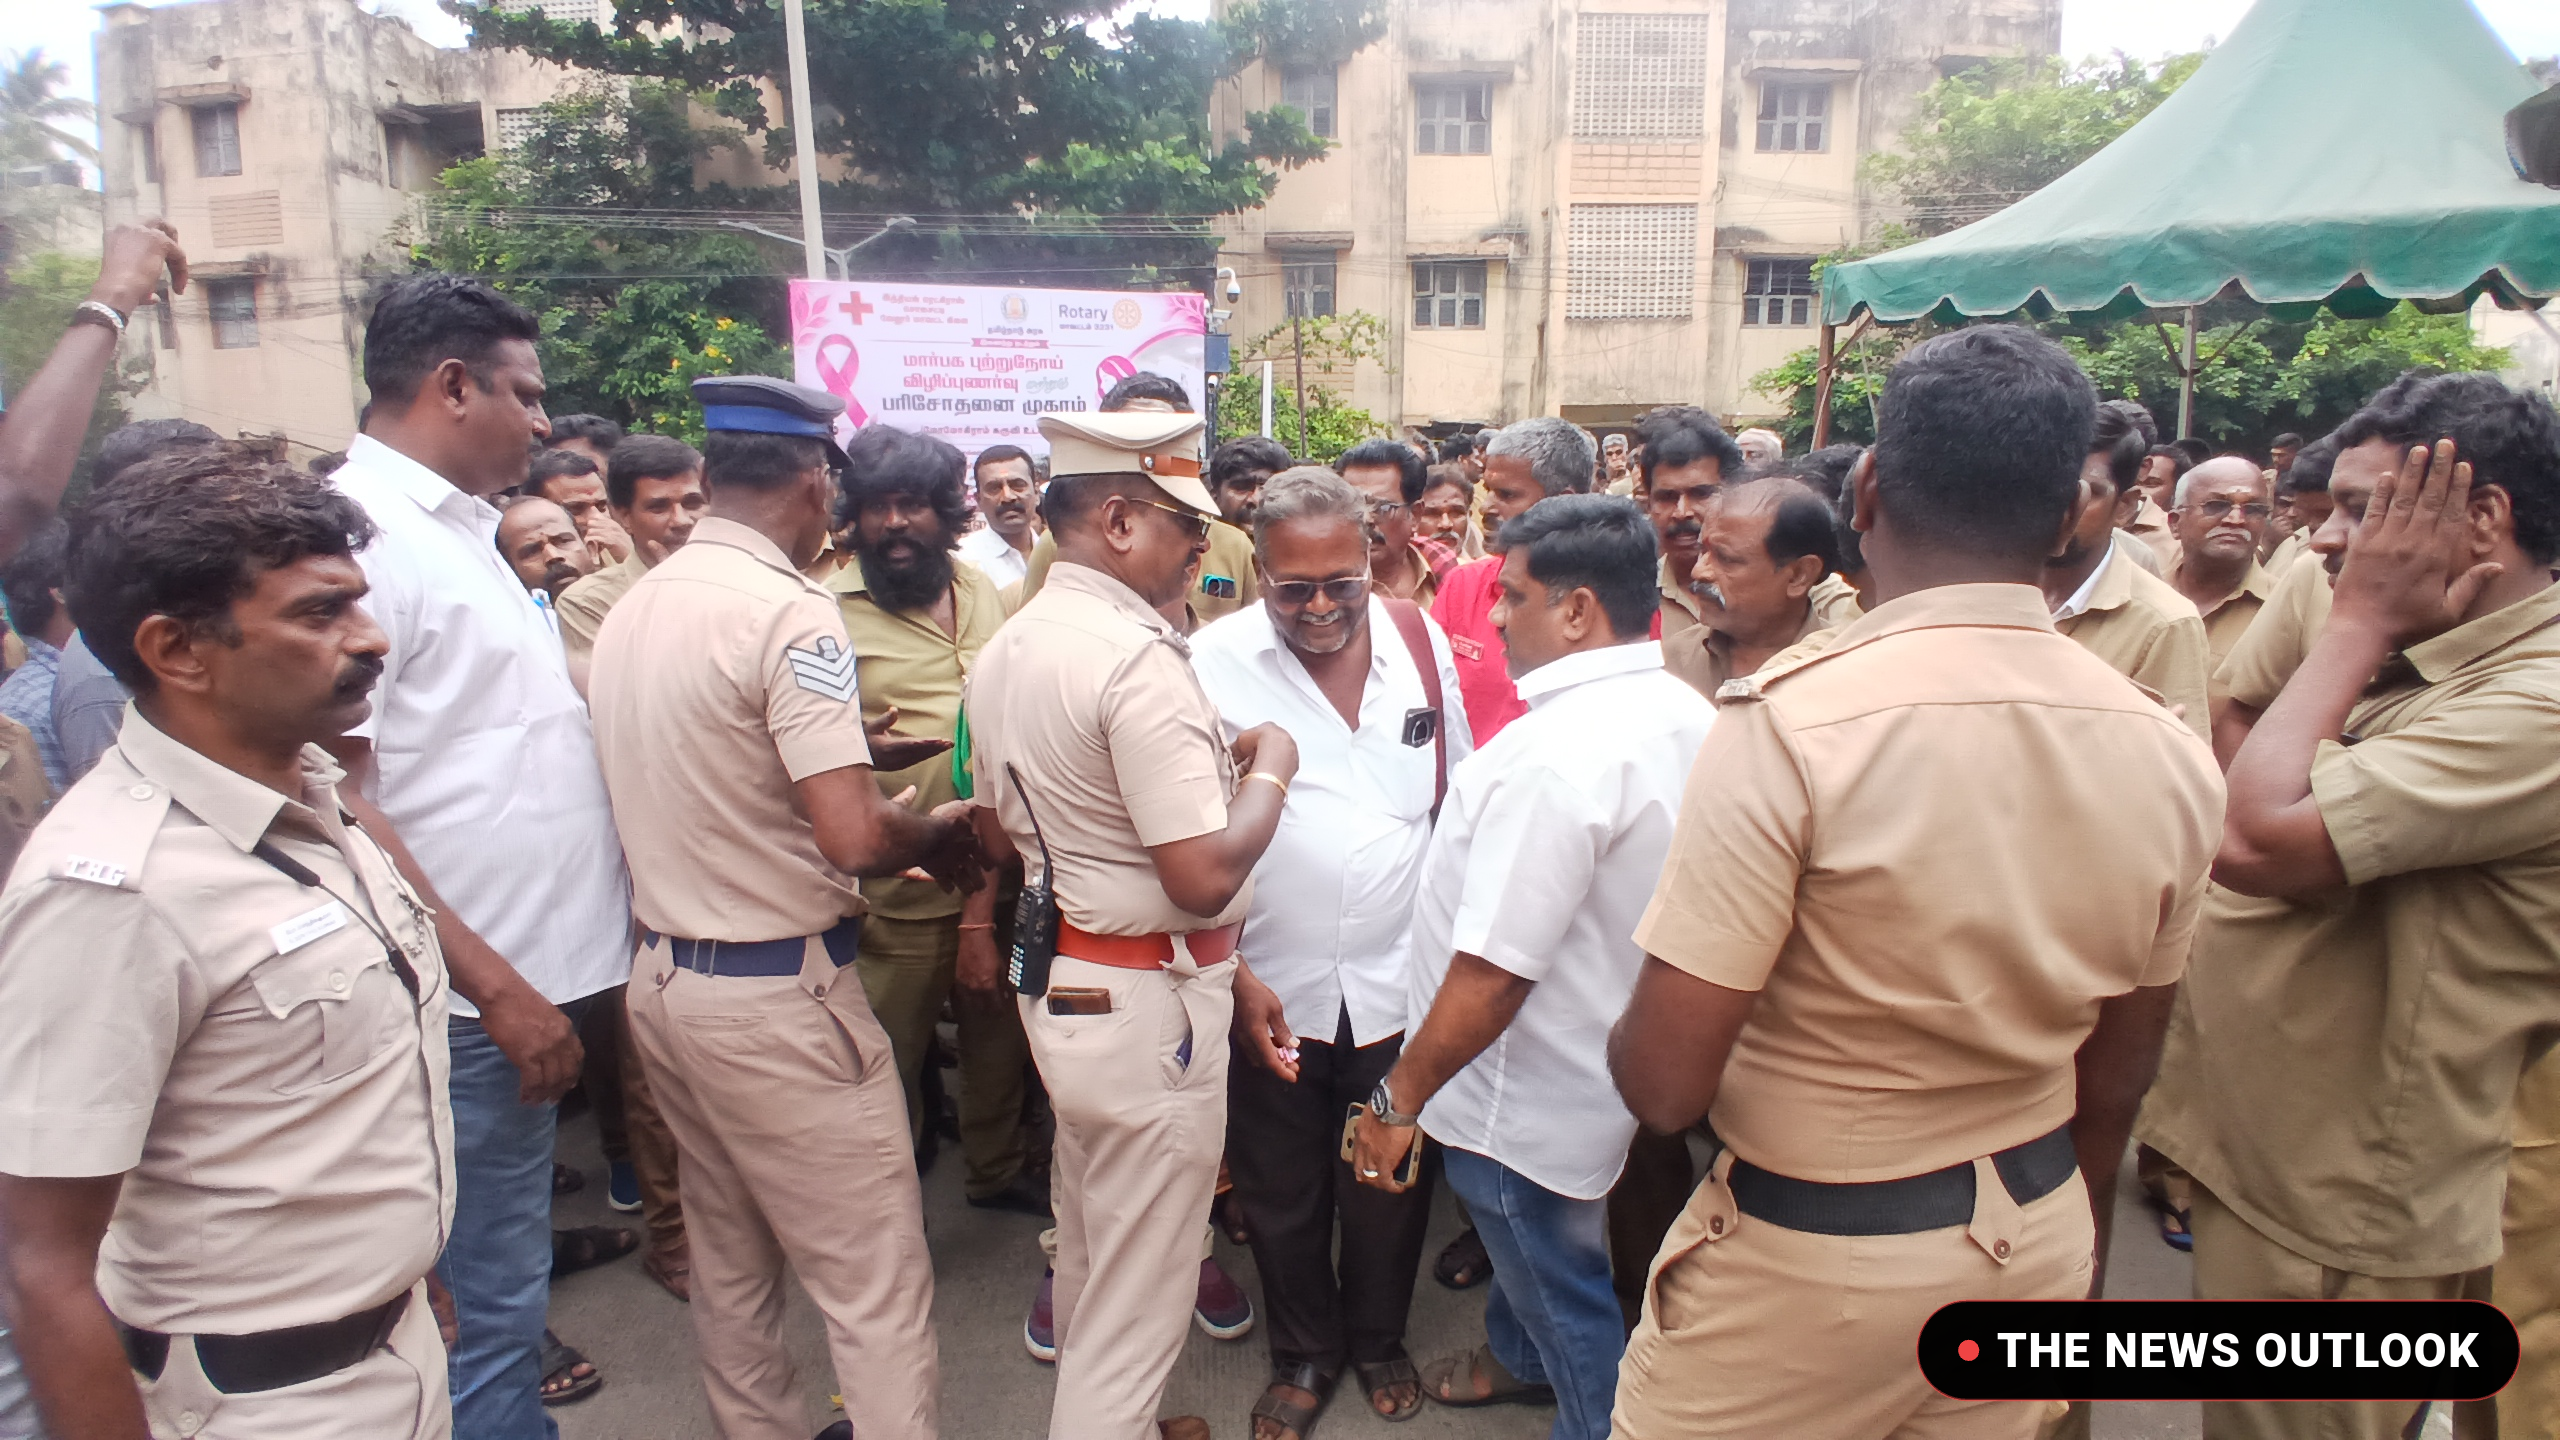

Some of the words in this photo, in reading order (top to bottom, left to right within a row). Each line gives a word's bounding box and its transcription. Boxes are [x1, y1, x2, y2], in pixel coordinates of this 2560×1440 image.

[1058, 304, 1108, 322] Rotary
[1094, 323, 1114, 331] 3231
[903, 351, 965, 368] மார்பக
[970, 352, 1064, 374] புற்றுநோய்
[903, 373, 1019, 393] விழிப்புணர்வு
[882, 393, 1015, 416] பரிசோதனை
[1022, 395, 1087, 416] முகாம்
[992, 426, 1021, 437] கருவி
